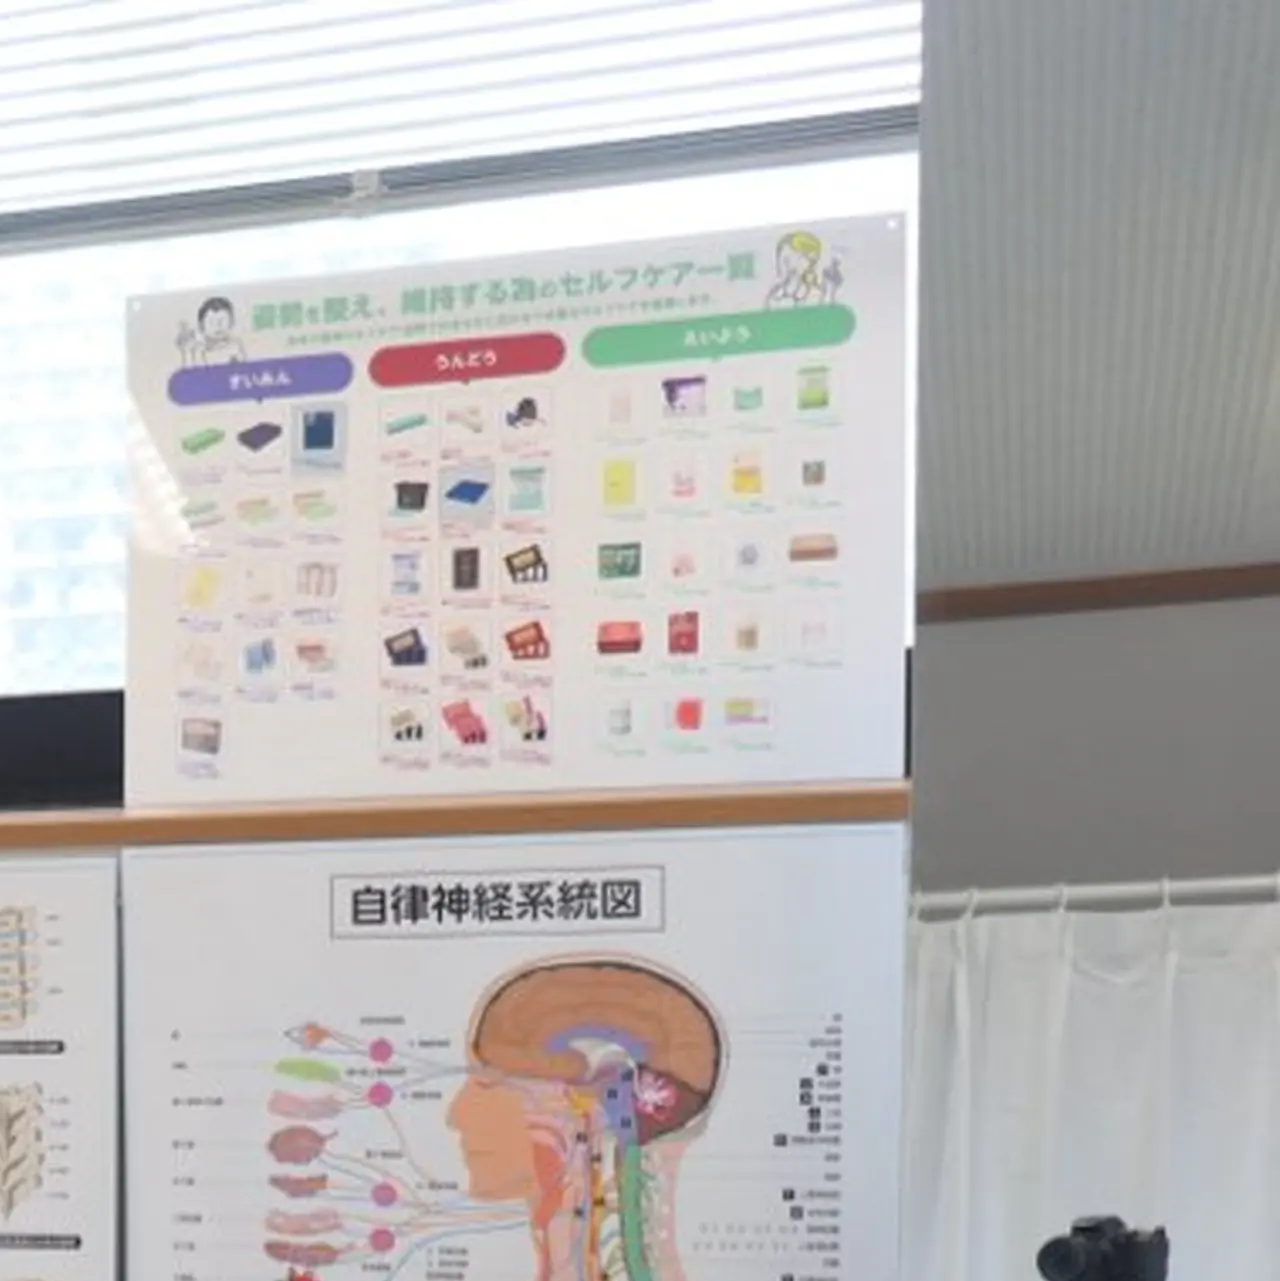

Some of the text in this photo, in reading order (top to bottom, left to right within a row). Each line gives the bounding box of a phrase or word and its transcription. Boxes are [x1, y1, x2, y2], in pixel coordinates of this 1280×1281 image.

[436, 349, 498, 371] うんどう
[350, 878, 643, 927] 自律神経系統図
